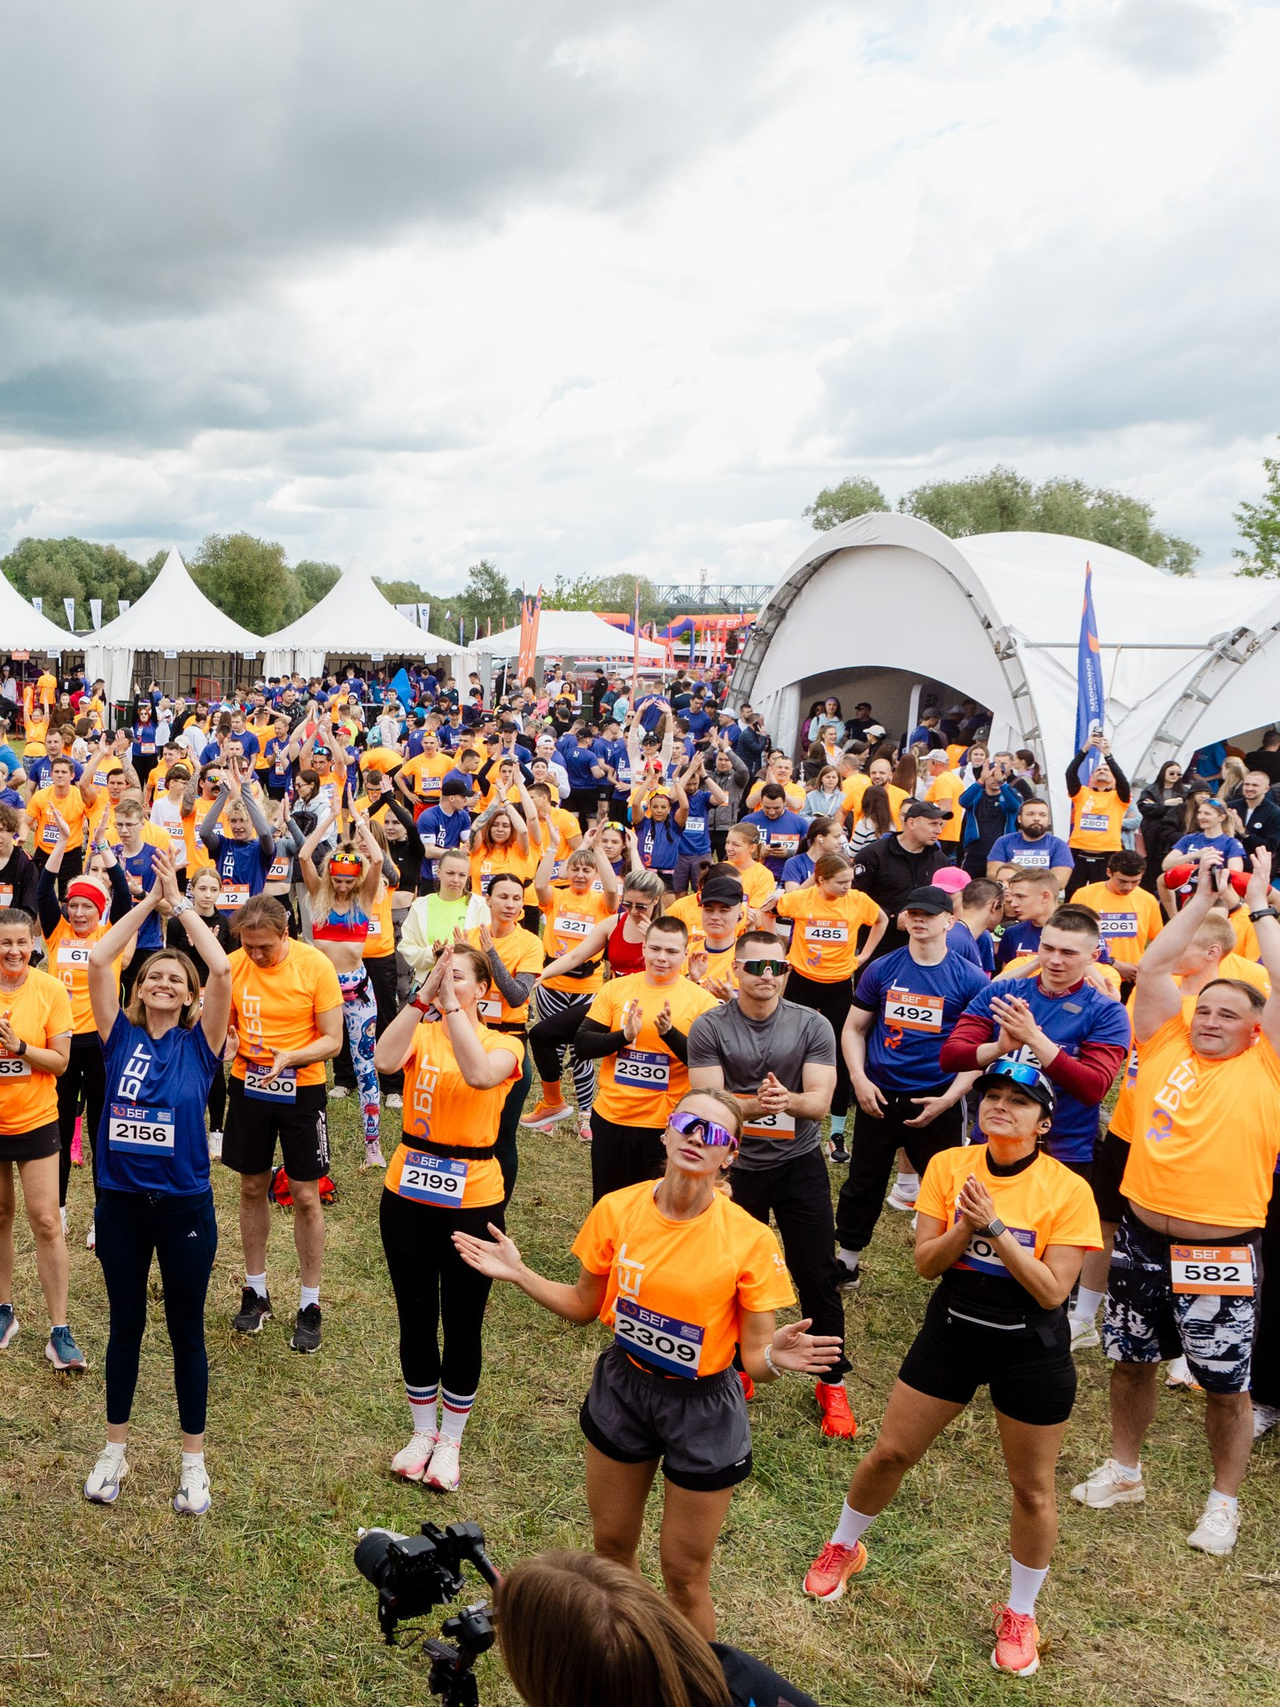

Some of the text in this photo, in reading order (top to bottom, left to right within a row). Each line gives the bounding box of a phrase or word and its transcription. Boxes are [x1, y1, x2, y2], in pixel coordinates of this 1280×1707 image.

[1082, 820, 1106, 828] 2801
[1016, 857, 1047, 865] 2589
[225, 894, 238, 903] 12
[562, 920, 587, 933] 321
[1100, 923, 1134, 931] 2061
[811, 930, 842, 939] 485
[72, 951, 88, 961] 61
[243, 986, 262, 1036] БЕГ
[893, 1006, 933, 1022] 492
[630, 1052, 649, 1061] БЕГ
[117, 1044, 153, 1101] БЕГ
[618, 1062, 666, 1080] 2330
[414, 1054, 440, 1115] БЕГ
[126, 1109, 150, 1120] БЕГ
[116, 1123, 167, 1143] 2156
[420, 1156, 443, 1169] БЕГ
[406, 1170, 458, 1192] 2199
[1192, 1250, 1221, 1260] БЕГ
[1184, 1265, 1241, 1282] 582
[639, 1309, 670, 1328] БЕГ
[618, 1318, 697, 1365] 2309
